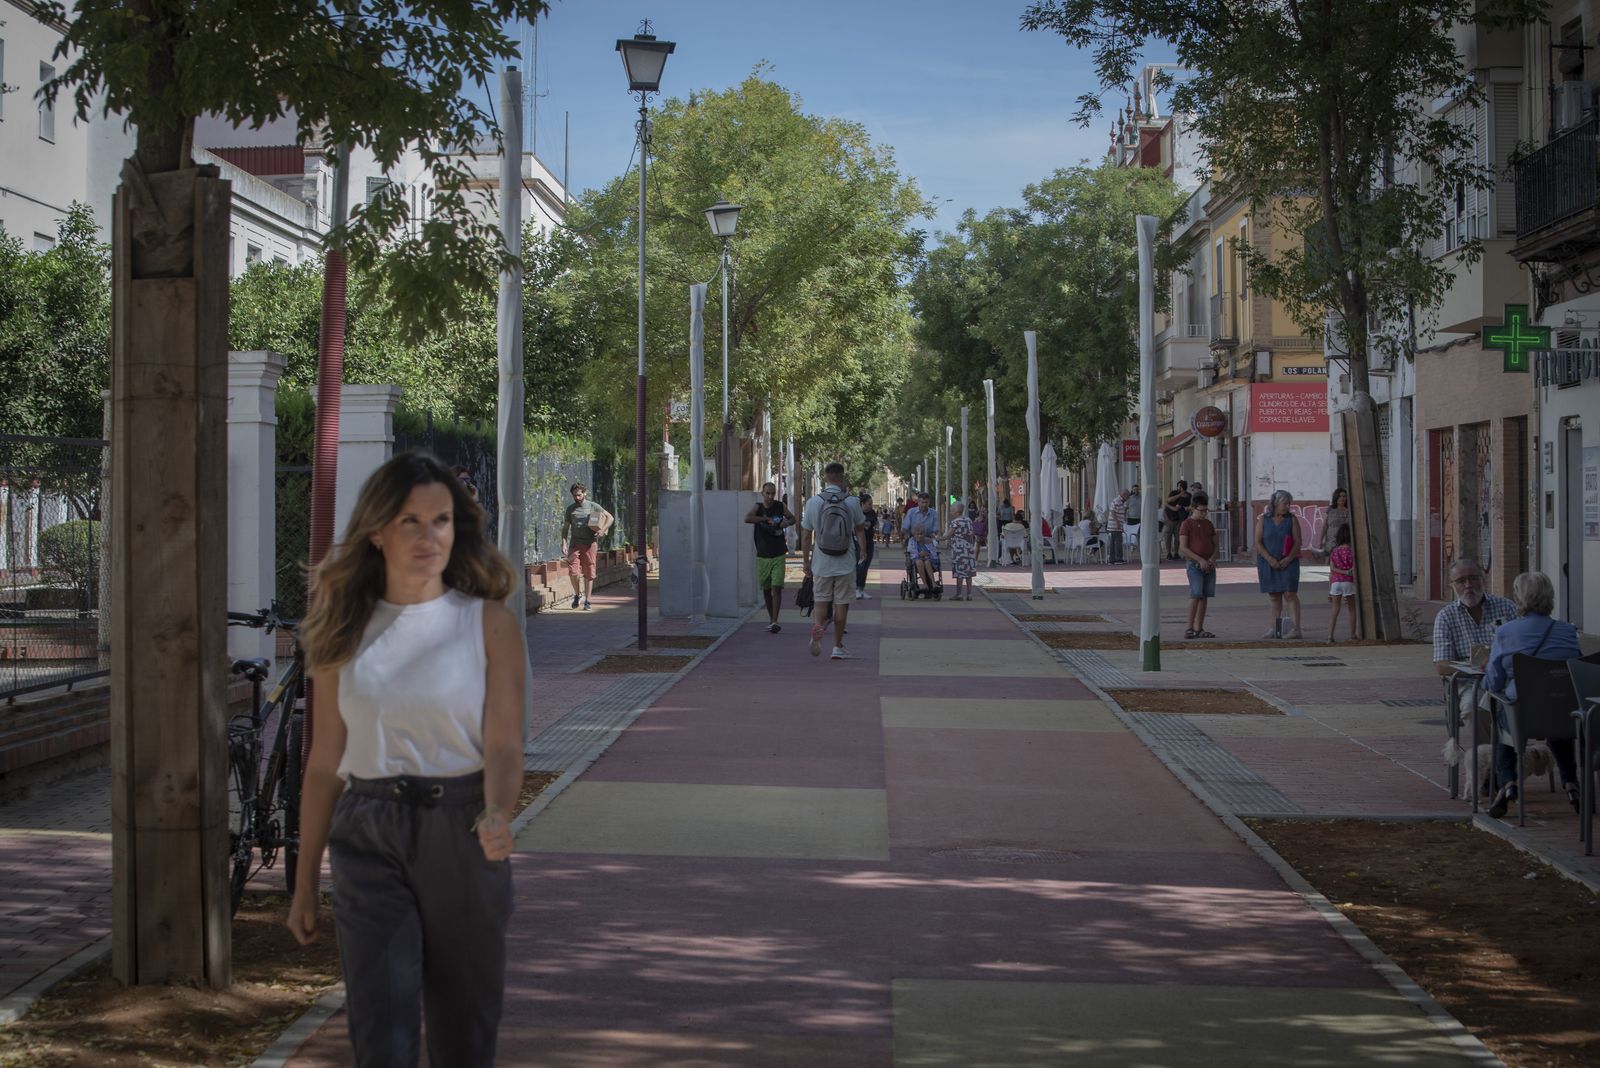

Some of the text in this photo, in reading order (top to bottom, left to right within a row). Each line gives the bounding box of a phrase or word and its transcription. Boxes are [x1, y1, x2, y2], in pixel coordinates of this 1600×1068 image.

[1259, 400, 1290, 408] CILINDROS
[1290, 400, 1299, 408] DE
[1299, 400, 1317, 408] ALTA
